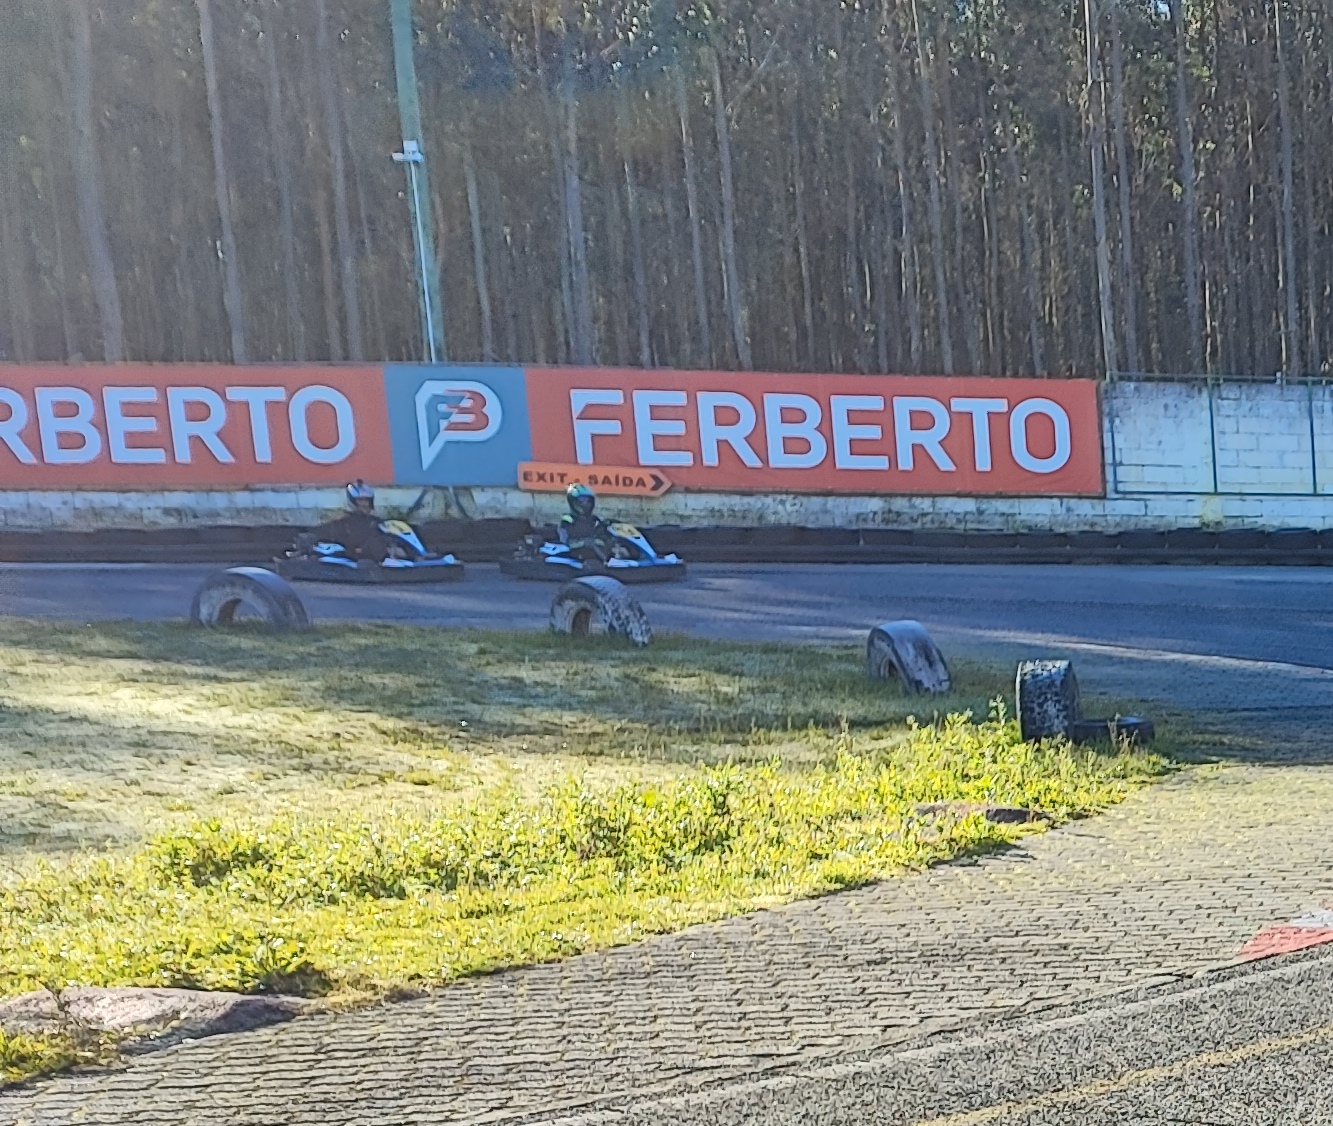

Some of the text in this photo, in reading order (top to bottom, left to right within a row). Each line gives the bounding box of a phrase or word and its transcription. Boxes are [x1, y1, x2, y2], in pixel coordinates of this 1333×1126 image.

[0, 384, 356, 466] RBERTO
[569, 388, 1073, 475] FERBERTO
[523, 470, 647, 488] EXIT SAÍDA
